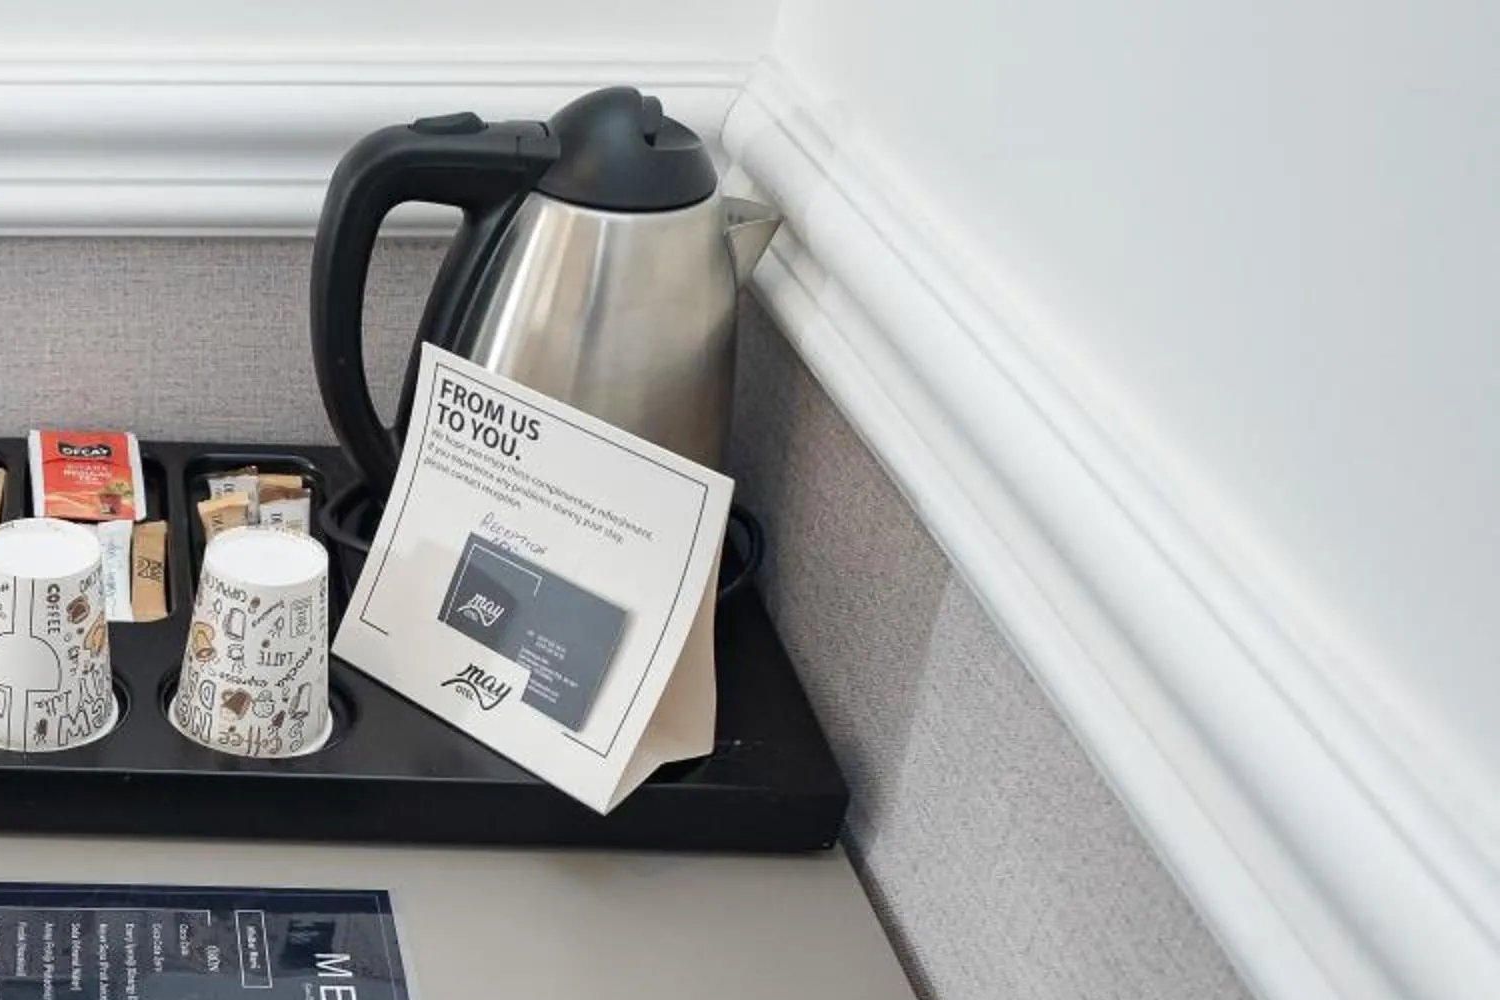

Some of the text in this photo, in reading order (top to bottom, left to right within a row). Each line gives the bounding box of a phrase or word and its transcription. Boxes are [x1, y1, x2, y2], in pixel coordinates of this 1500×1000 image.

[436, 404, 521, 461] TO YOU.
[441, 378, 541, 441] FROM US
[46, 583, 61, 635] COFFEE
